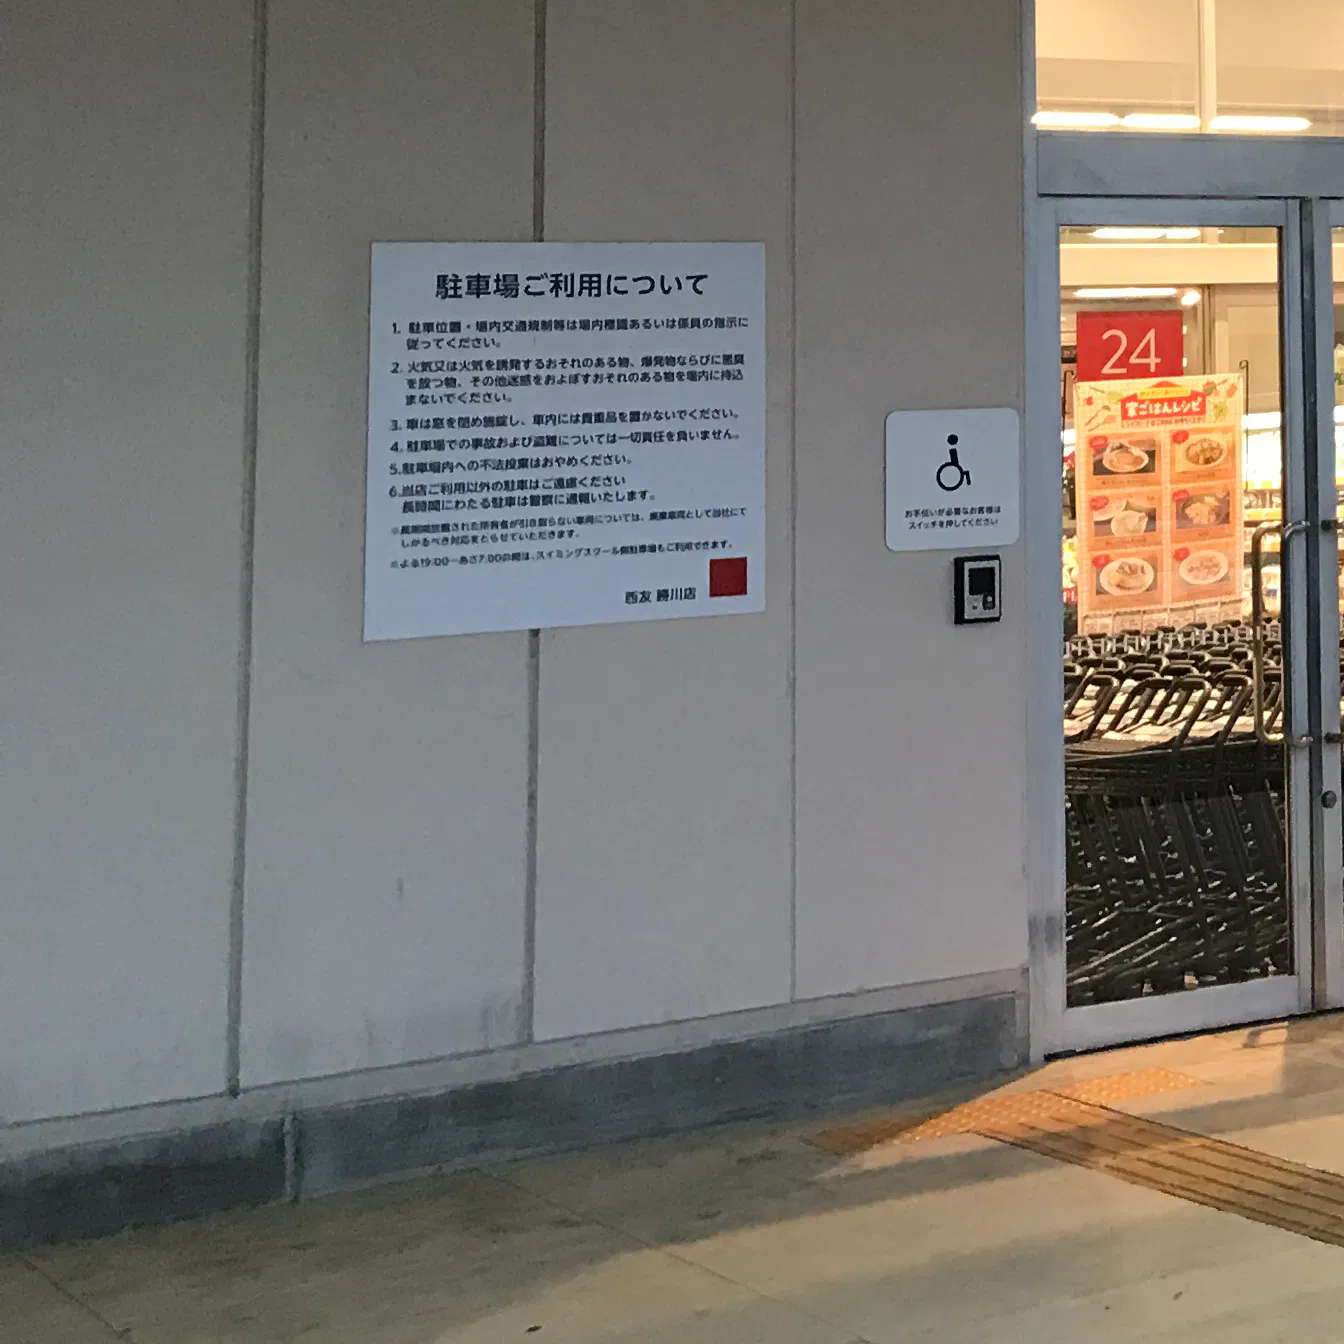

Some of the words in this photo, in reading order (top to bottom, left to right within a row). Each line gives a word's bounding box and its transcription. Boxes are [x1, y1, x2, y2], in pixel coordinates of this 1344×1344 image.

[435, 272, 709, 300] 駐車場ご利用について
[1100, 327, 1162, 375] 24
[1125, 396, 1202, 417] 家ごはんレシピ
